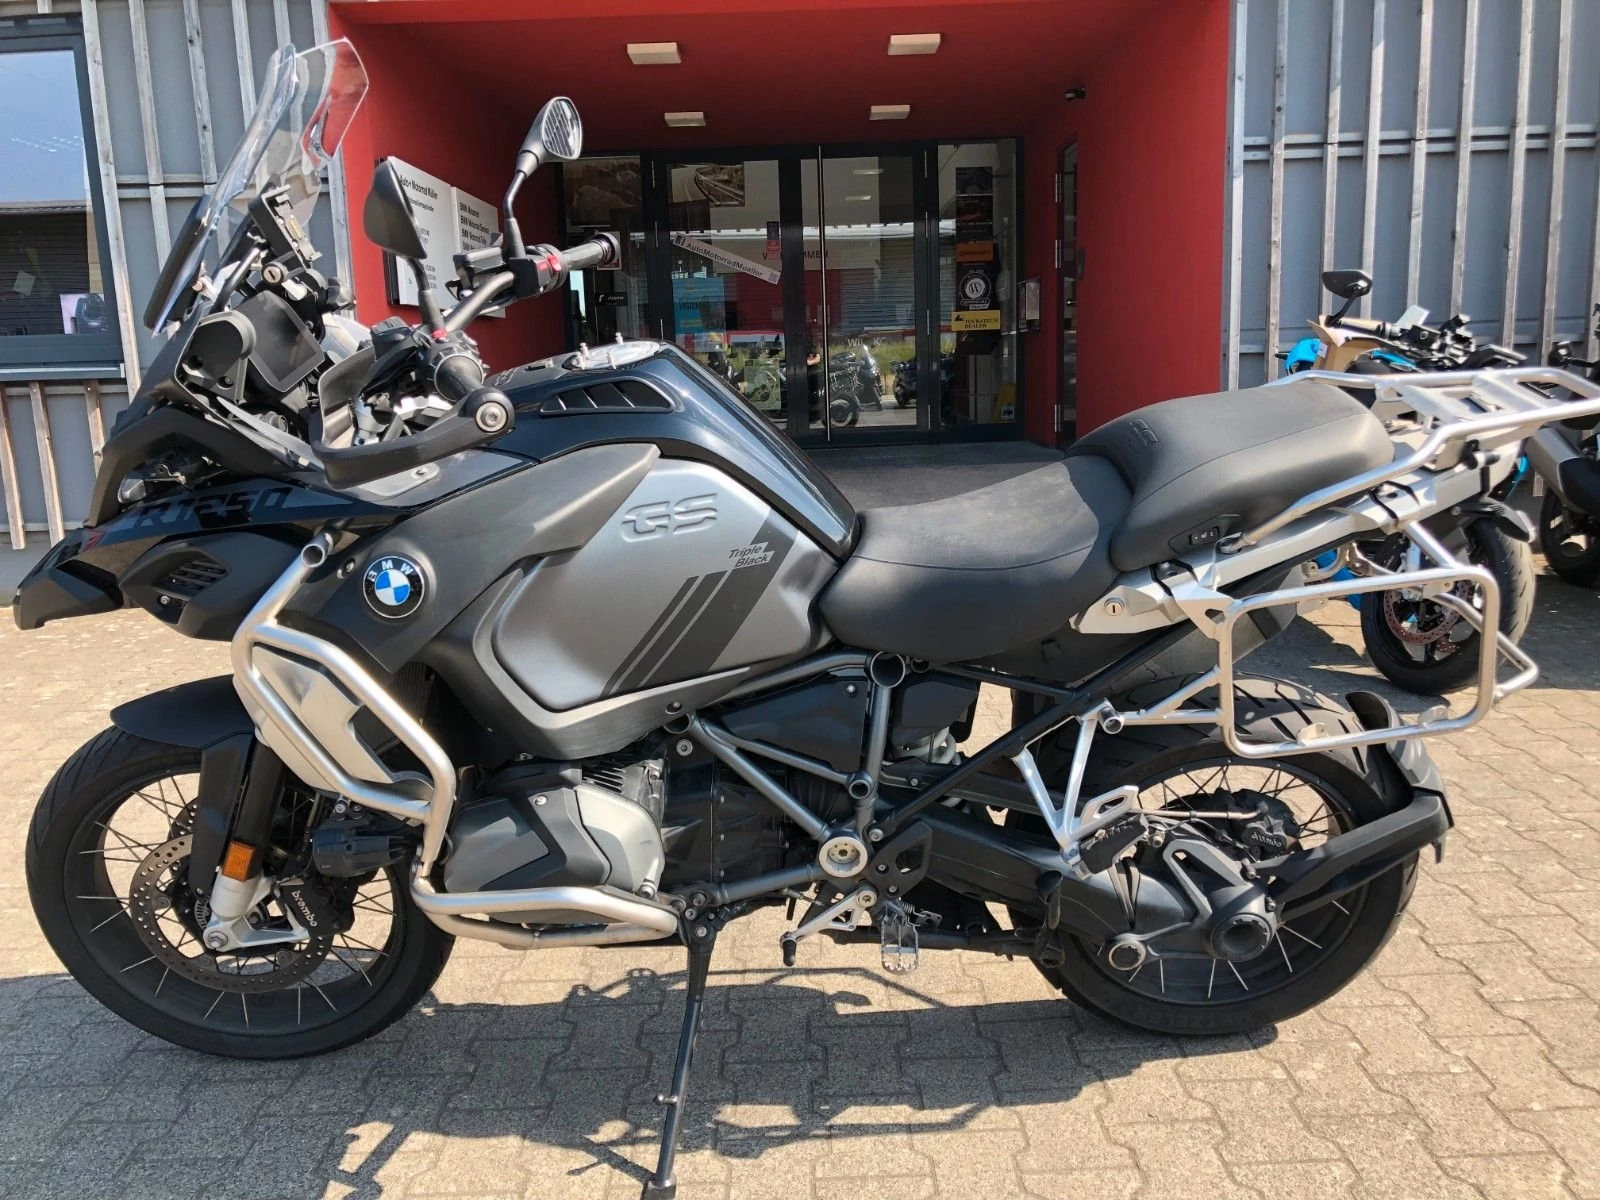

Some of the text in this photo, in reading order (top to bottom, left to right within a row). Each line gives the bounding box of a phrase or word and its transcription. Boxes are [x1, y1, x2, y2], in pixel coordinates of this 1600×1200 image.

[686, 242, 764, 276] AutoMotorradMueller
[621, 493, 718, 542] GS
[729, 545, 763, 559] Triple
[735, 553, 769, 568] Black
[367, 559, 414, 582] BMW
[291, 890, 318, 927] brembo
